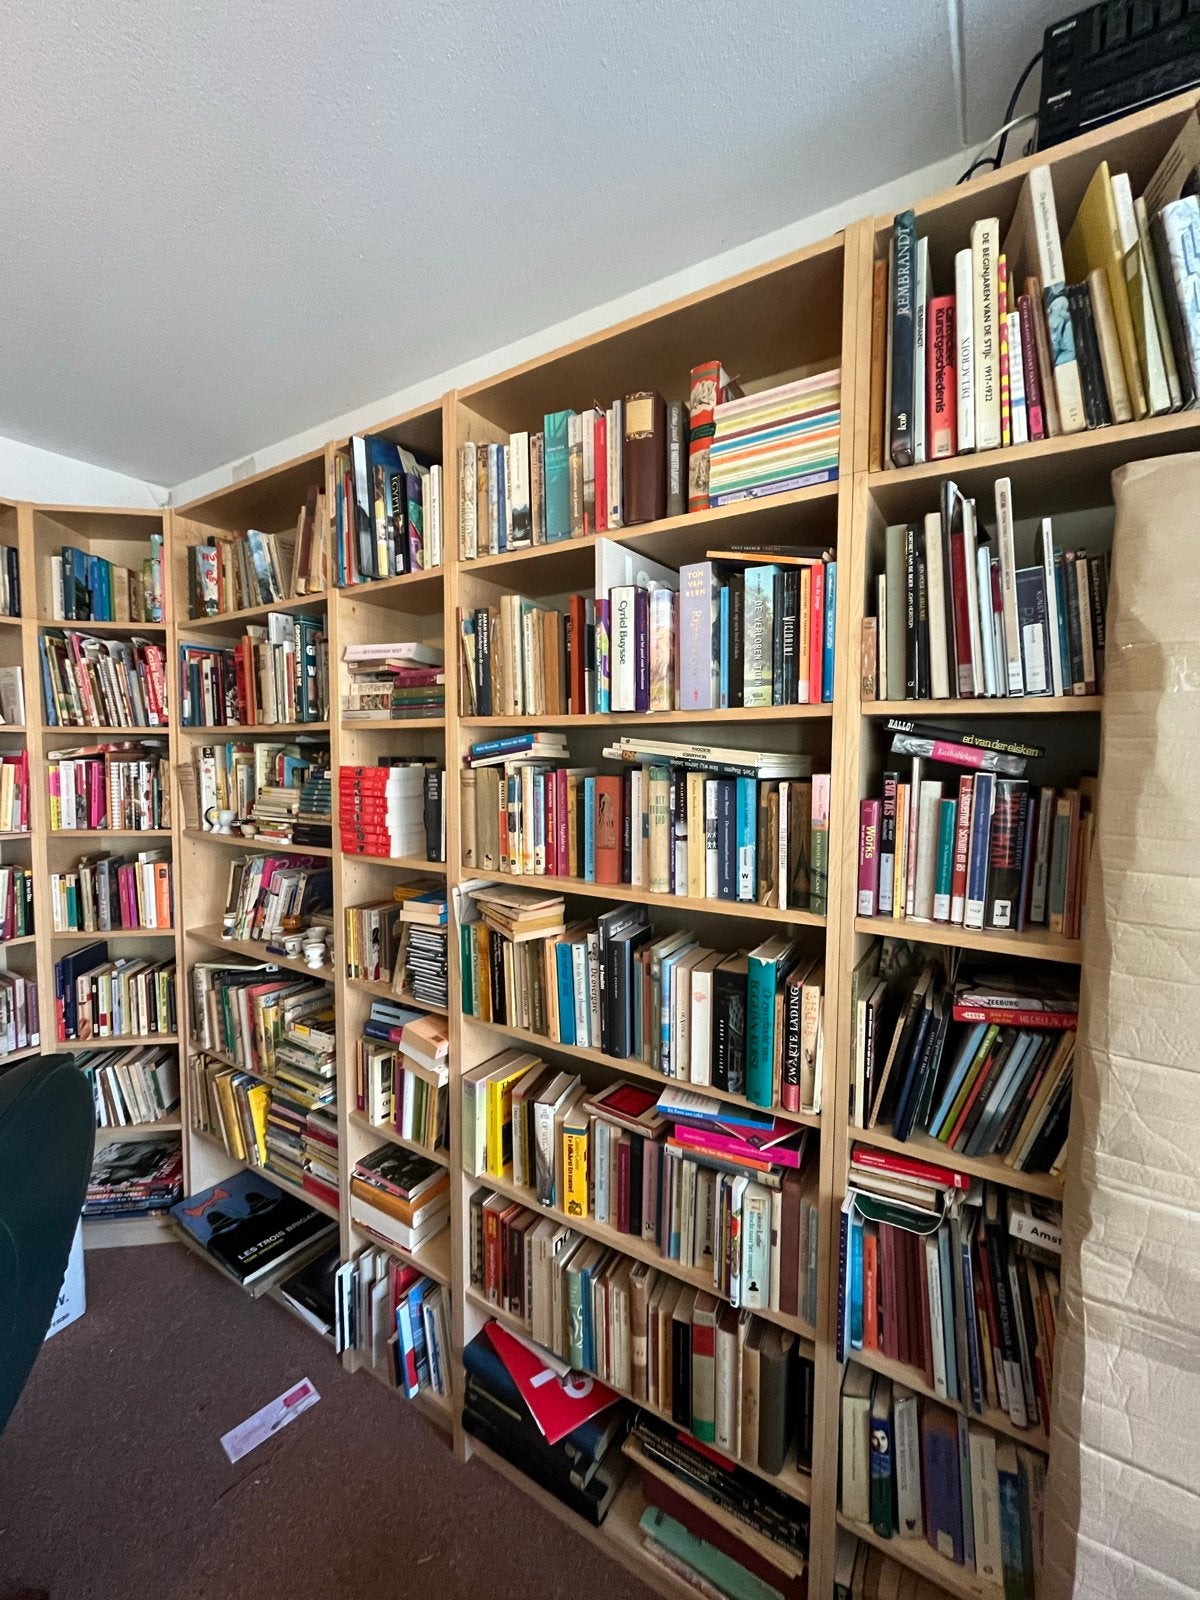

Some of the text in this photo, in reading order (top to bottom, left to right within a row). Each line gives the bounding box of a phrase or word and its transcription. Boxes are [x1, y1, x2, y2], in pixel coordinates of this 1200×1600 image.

[897, 227, 912, 316] REMBRANDT
[982, 232, 993, 402] DE BEGINJAREN VAN DE STIJL 1917-1922
[935, 307, 946, 414] Kunstgeschiedenis
[961, 336, 971, 399] DELACROIX
[687, 569, 704, 579] TON
[687, 580, 703, 588] VAN
[618, 600, 628, 665] Cyriel Buysse
[753, 600, 762, 687] DE VERLOREN TUIN
[888, 719, 914, 732] HALLO!
[962, 735, 1039, 757] ed van der elsken
[884, 779, 896, 797] EVA
[884, 800, 896, 816] TAS
[865, 825, 876, 859] Works
[956, 863, 966, 872] as
[591, 967, 599, 1014] De overgave
[788, 986, 800, 1084] ZWARTE LADING
[238, 1246, 258, 1260] LES
[257, 1230, 286, 1248] TROIS
[1031, 1226, 1062, 1246] Amst
